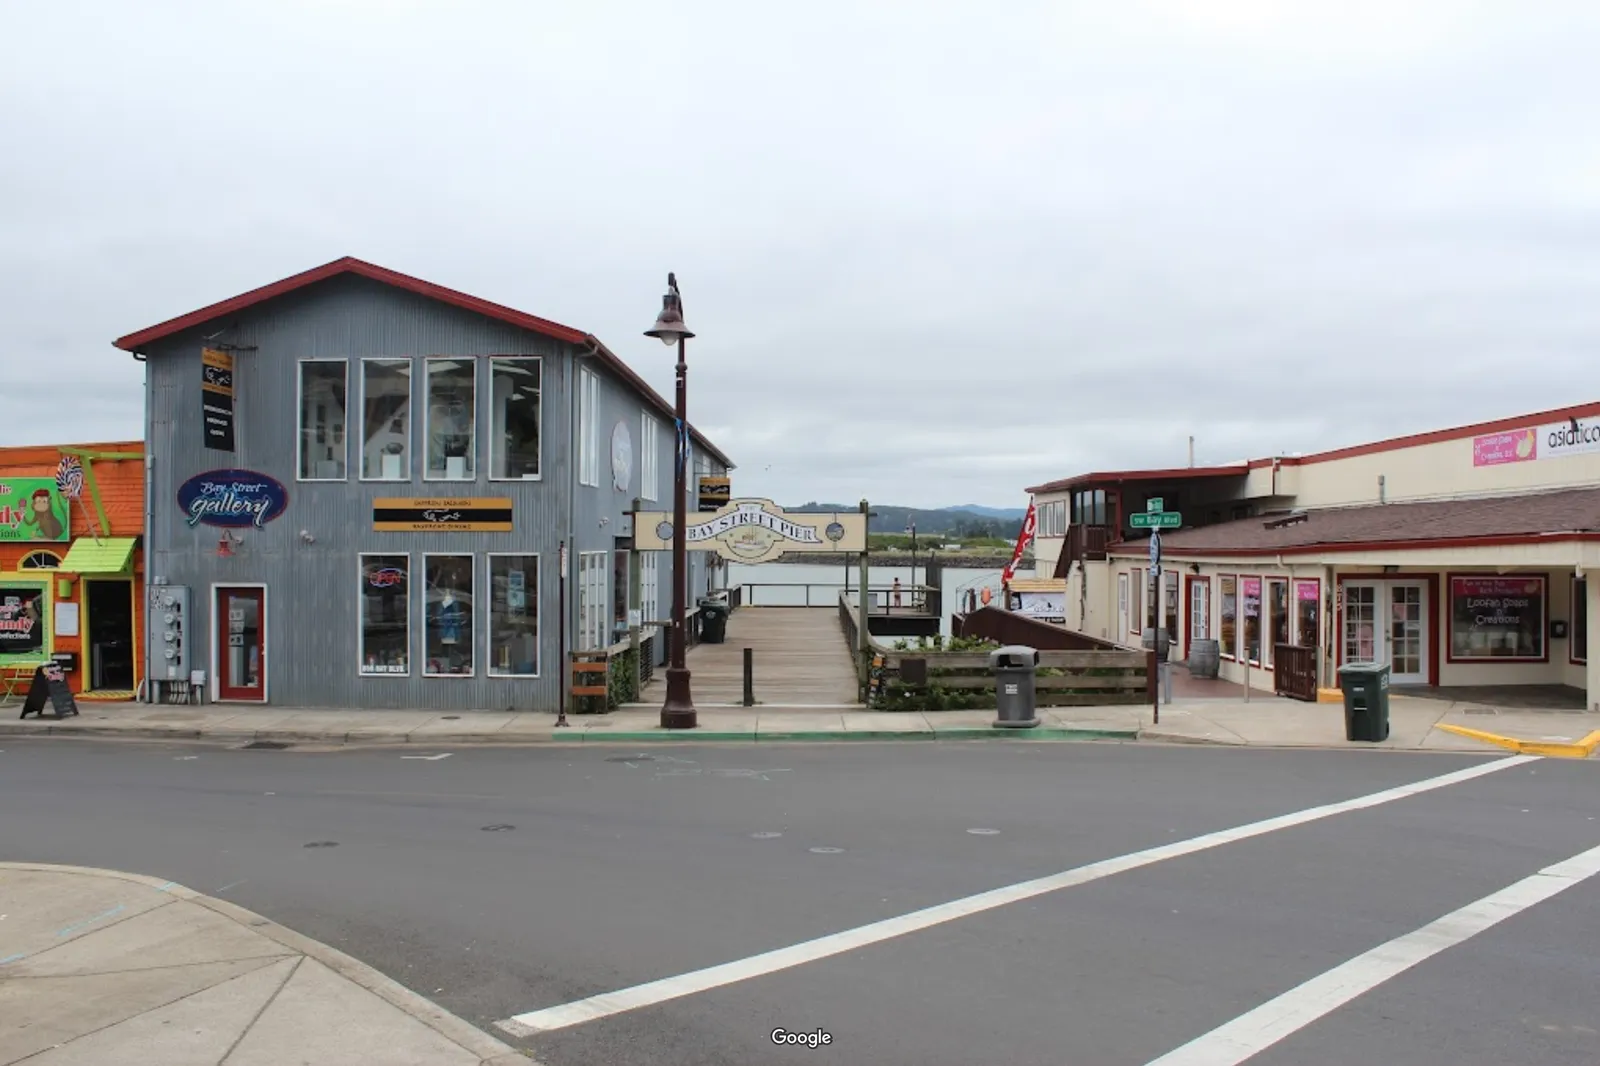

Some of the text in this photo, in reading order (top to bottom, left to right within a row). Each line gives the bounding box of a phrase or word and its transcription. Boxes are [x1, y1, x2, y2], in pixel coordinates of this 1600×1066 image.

[200, 482, 267, 494] Bay Street
[188, 492, 270, 527] gallery
[688, 512, 814, 541] BAY STREET PIER
[1475, 615, 1520, 625] Creations
